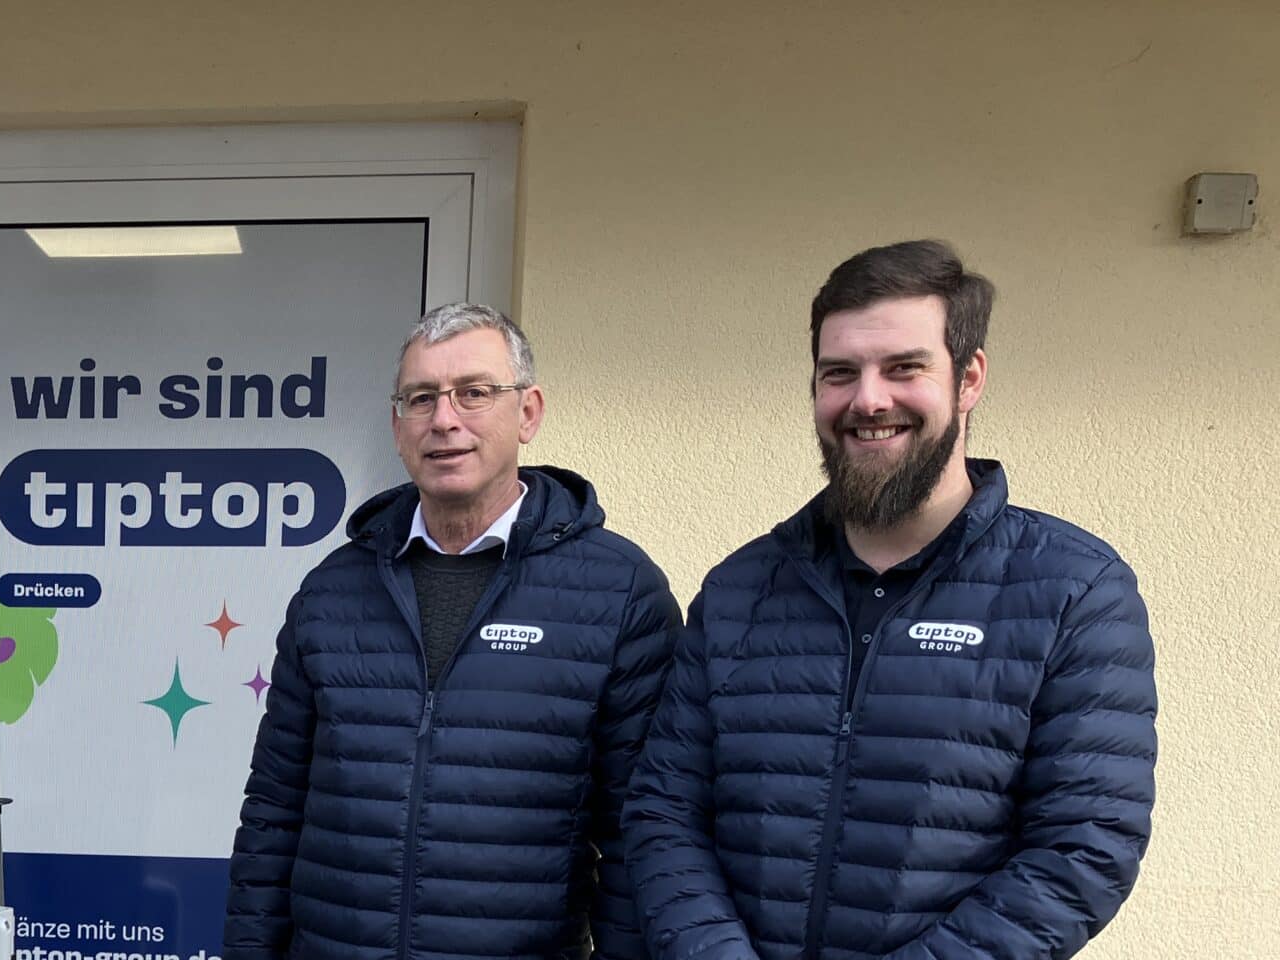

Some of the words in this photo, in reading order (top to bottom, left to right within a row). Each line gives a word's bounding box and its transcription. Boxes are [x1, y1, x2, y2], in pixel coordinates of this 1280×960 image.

[10, 358, 141, 419] wir
[159, 356, 327, 419] sind
[13, 583, 85, 598] Drücken
[490, 642, 527, 651] GROUP
[919, 641, 962, 652] GROUP
[16, 916, 71, 939] änze
[77, 919, 116, 941] mit
[122, 925, 164, 942] uns
